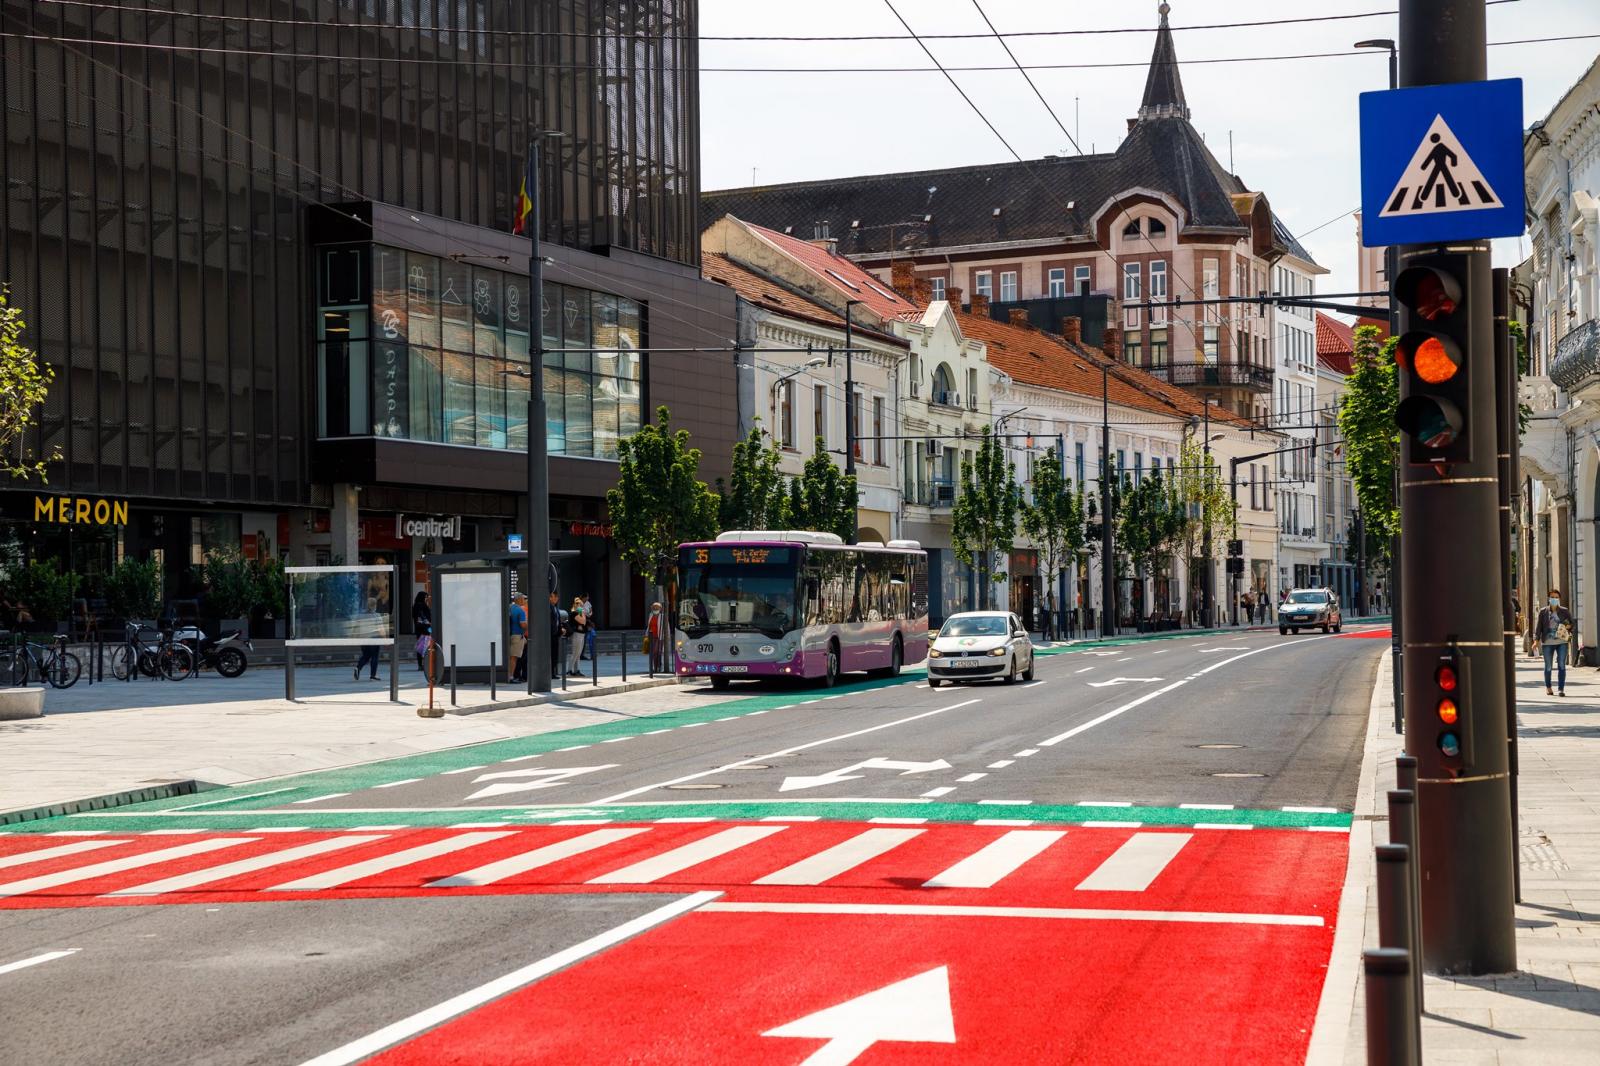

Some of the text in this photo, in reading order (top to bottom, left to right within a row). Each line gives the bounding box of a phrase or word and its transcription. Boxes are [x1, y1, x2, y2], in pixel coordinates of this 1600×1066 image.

[34, 496, 128, 525] MERON
[695, 549, 709, 563] 35
[698, 643, 714, 653] 970
